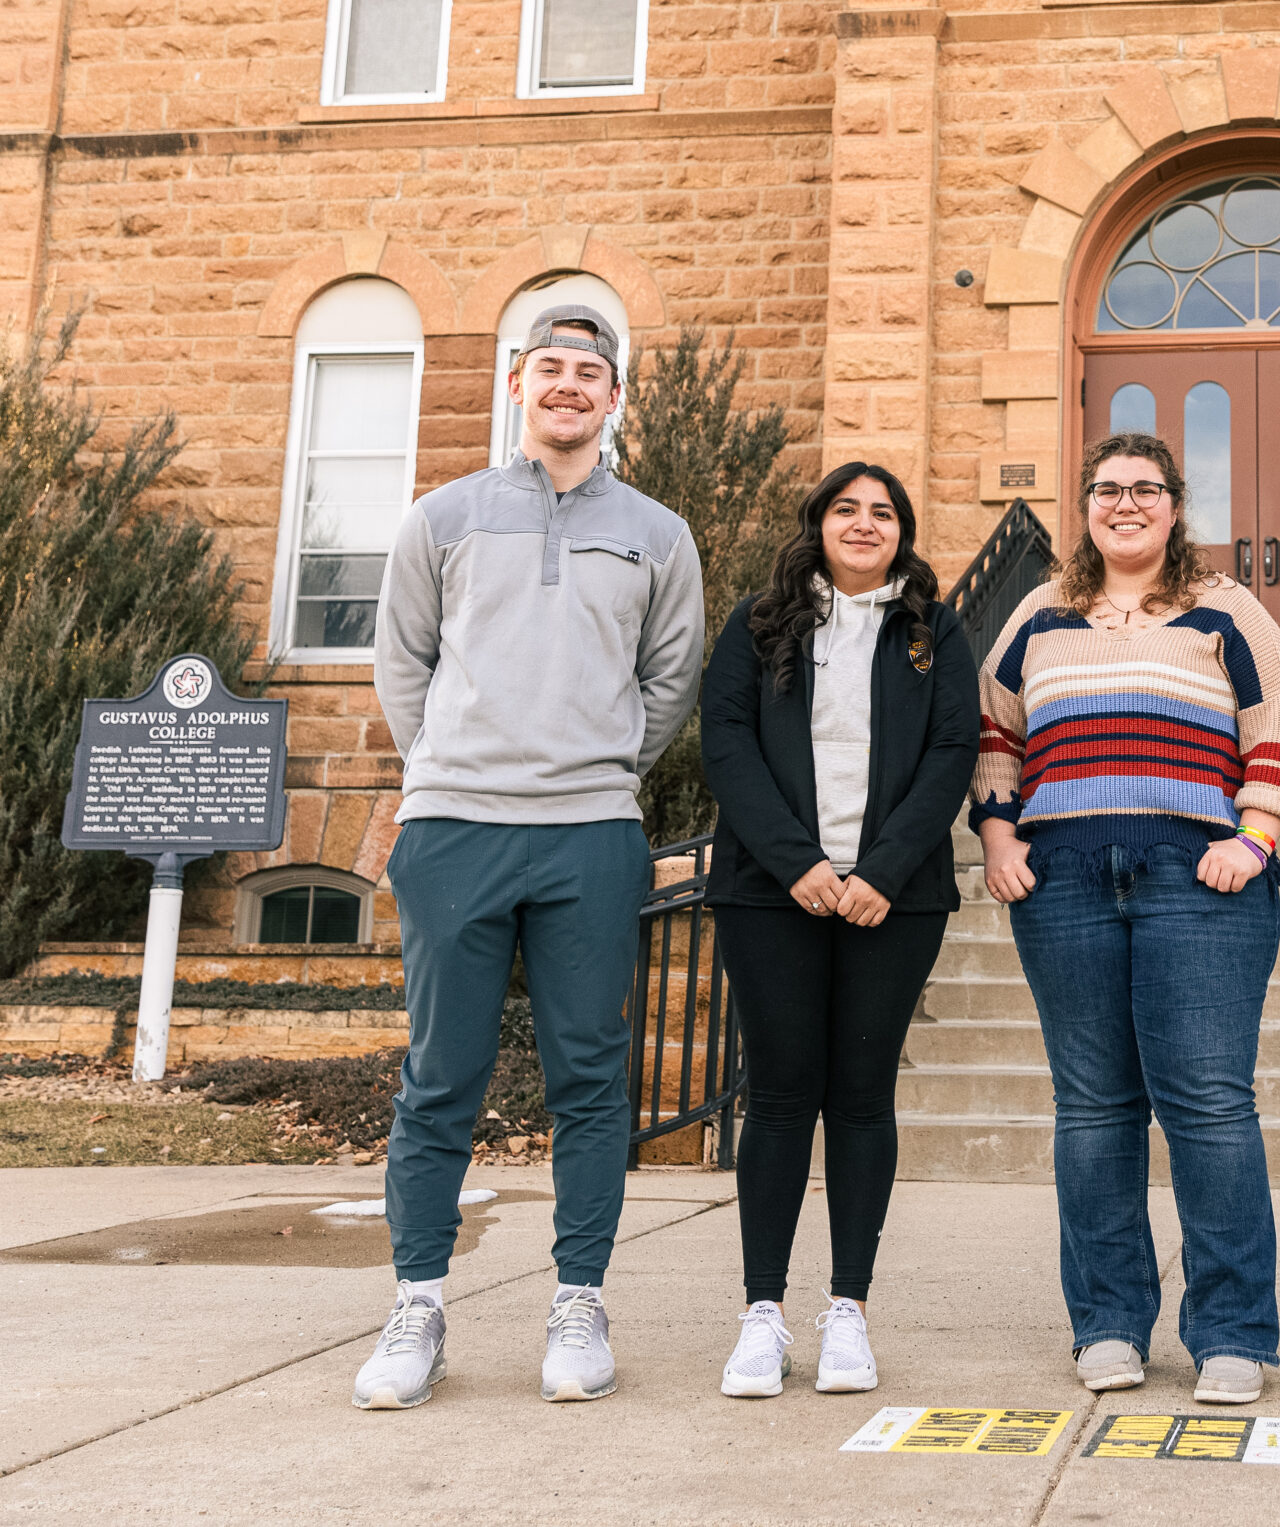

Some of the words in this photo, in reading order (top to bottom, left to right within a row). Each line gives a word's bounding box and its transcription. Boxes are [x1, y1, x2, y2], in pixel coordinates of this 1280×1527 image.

[99, 712, 177, 724] GUSTAVUS
[187, 712, 269, 724] ADOLPHUS
[149, 726, 216, 739] COLLEGE
[927, 1413, 987, 1432] SAY
[999, 1411, 1061, 1423] BE
[1093, 1442, 1161, 1458] BE
[1173, 1433, 1241, 1457] SAY
